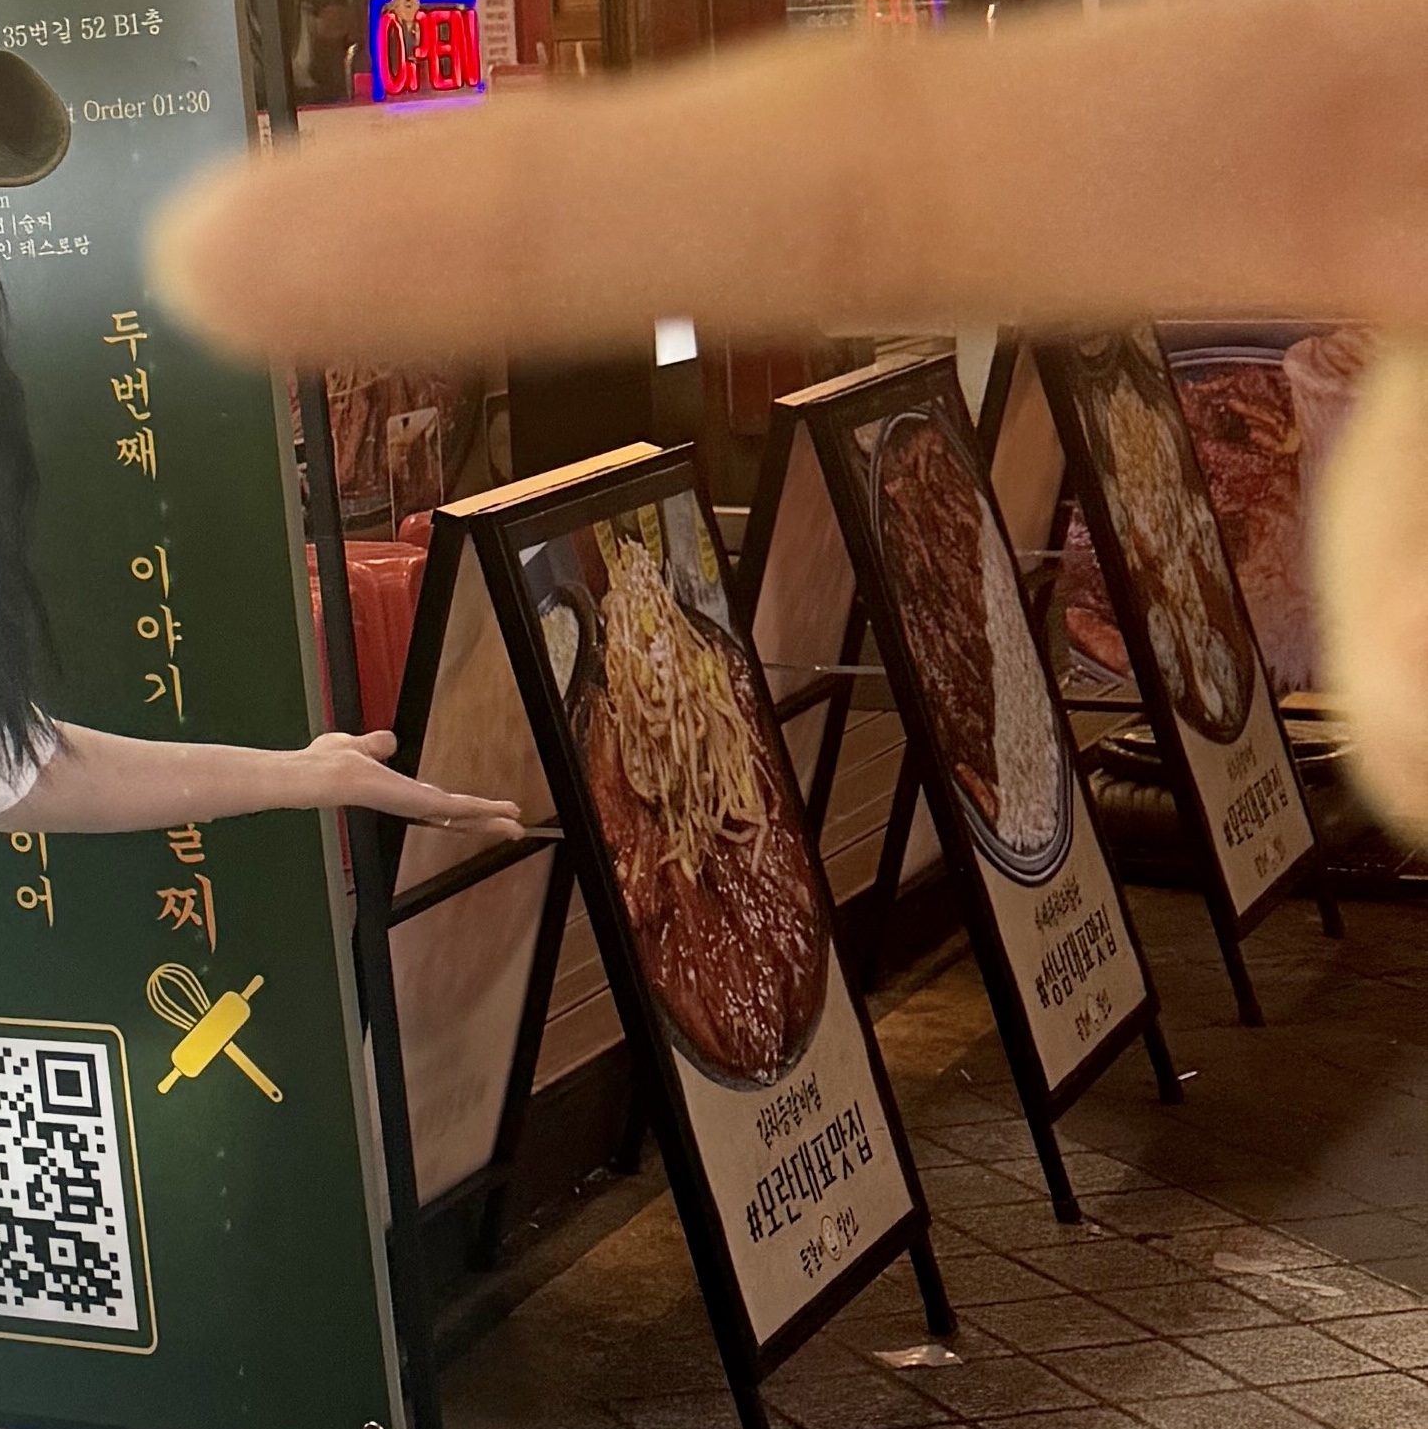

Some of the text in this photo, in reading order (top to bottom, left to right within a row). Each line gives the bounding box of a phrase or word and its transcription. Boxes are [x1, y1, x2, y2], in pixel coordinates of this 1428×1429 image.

[2, 20, 71, 48] 35번길
[81, 16, 107, 40] 52
[114, 8, 164, 37] B1층
[83, 100, 146, 122] Order
[152, 90, 211, 116] 01:30
[103, 310, 156, 480] 두번째
[130, 546, 184, 721] 이야기
[746, 1100, 873, 1243] #모란대표맛집
